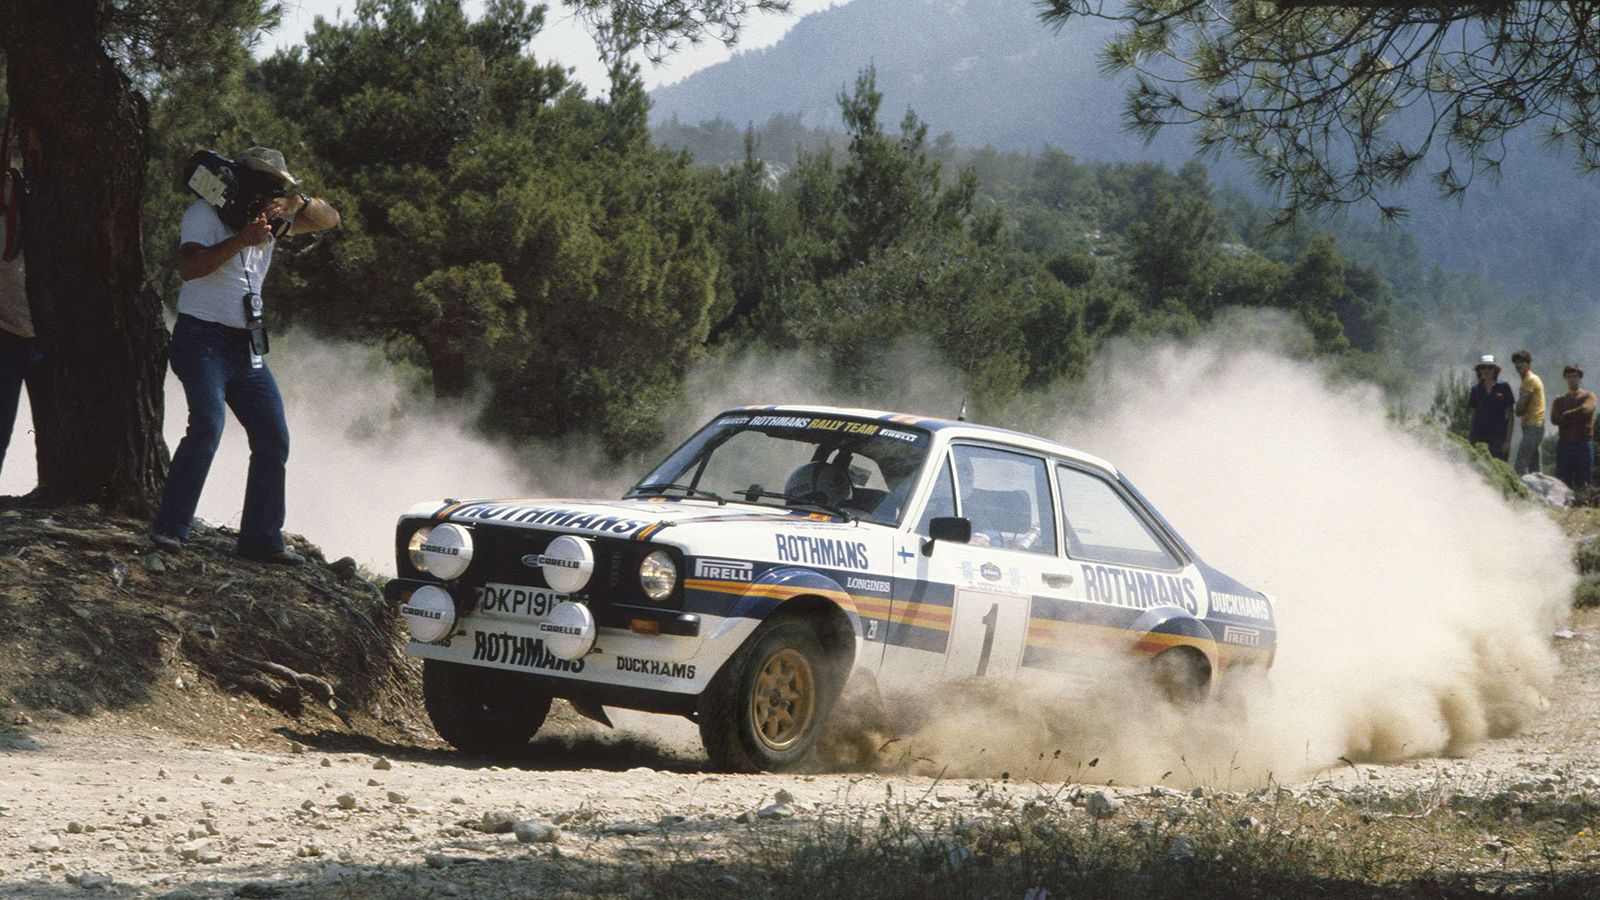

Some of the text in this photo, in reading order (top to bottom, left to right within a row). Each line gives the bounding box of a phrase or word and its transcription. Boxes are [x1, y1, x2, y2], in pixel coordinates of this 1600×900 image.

[749, 416, 879, 436] ROTHMANS RALLY TEAM
[879, 428, 918, 442] PIRELLI
[461, 504, 640, 534] ROTHMANS
[420, 543, 459, 556] CARELLO
[775, 533, 869, 570] ROTHMANS
[539, 556, 580, 569] CARELLO
[694, 558, 754, 581] PIRELLI
[846, 577, 891, 593] LONGINES
[1080, 563, 1199, 617] ROTHMANS
[402, 606, 442, 620] CARELLO
[1210, 591, 1270, 621] DUCKHAMS
[540, 623, 582, 636] CARELLO
[975, 602, 999, 677] 1
[1224, 625, 1261, 647] PIRELLI
[616, 655, 697, 680] DUCKHAMS
